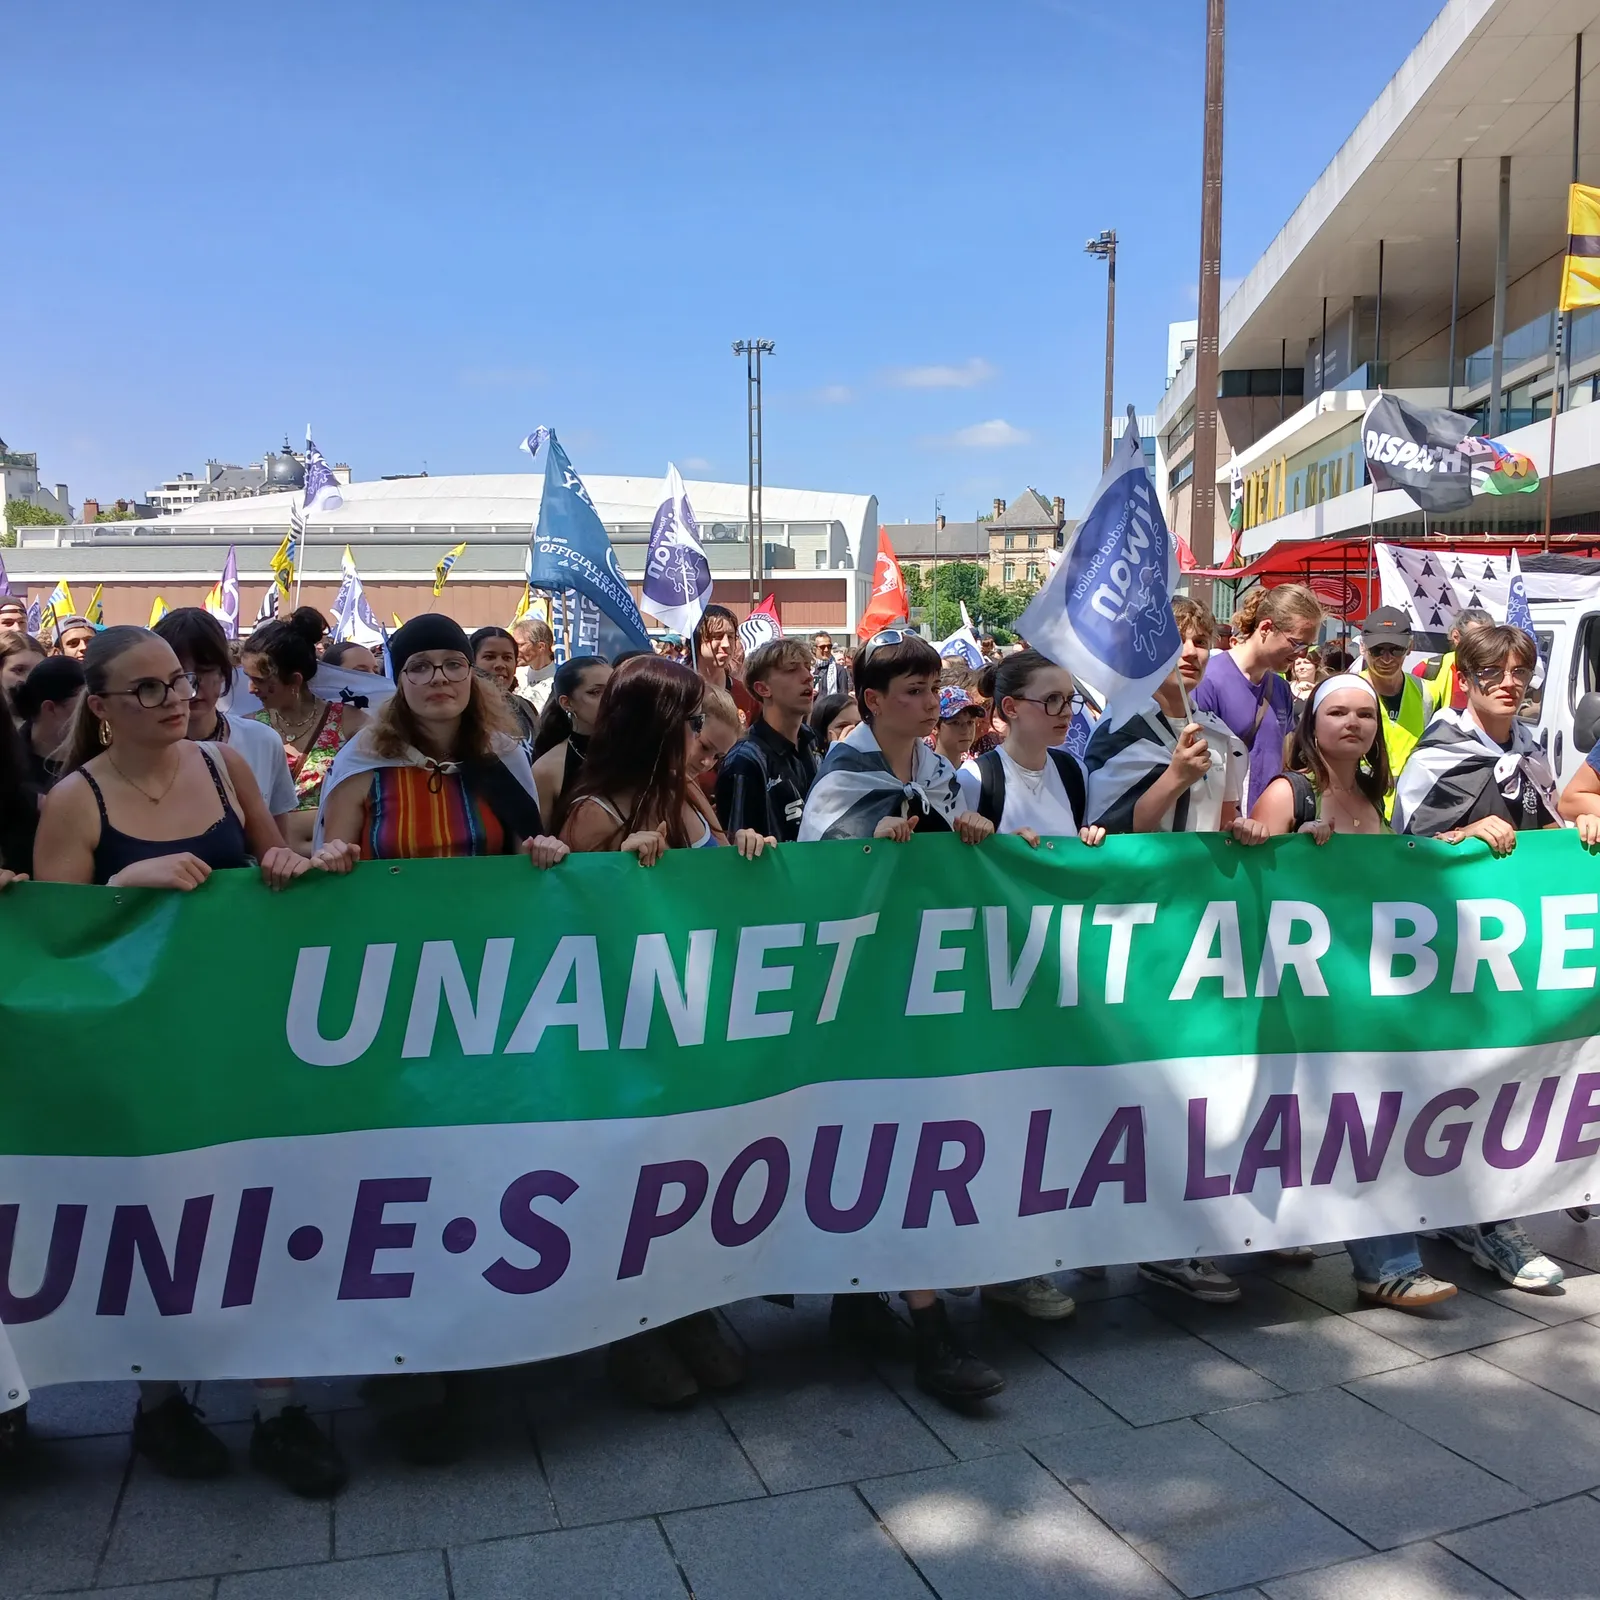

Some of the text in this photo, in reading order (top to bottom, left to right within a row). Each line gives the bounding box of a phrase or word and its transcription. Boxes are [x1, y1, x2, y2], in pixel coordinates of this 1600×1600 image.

[540, 543, 638, 617] OFFICIALISATION
[583, 570, 631, 616] LANGUE
[284, 893, 1599, 1068] UNANET EVIT AR BRE
[616, 1119, 986, 1280] POUR
[1018, 1105, 1148, 1218] LA
[1183, 1072, 1600, 1202] LANGUE
